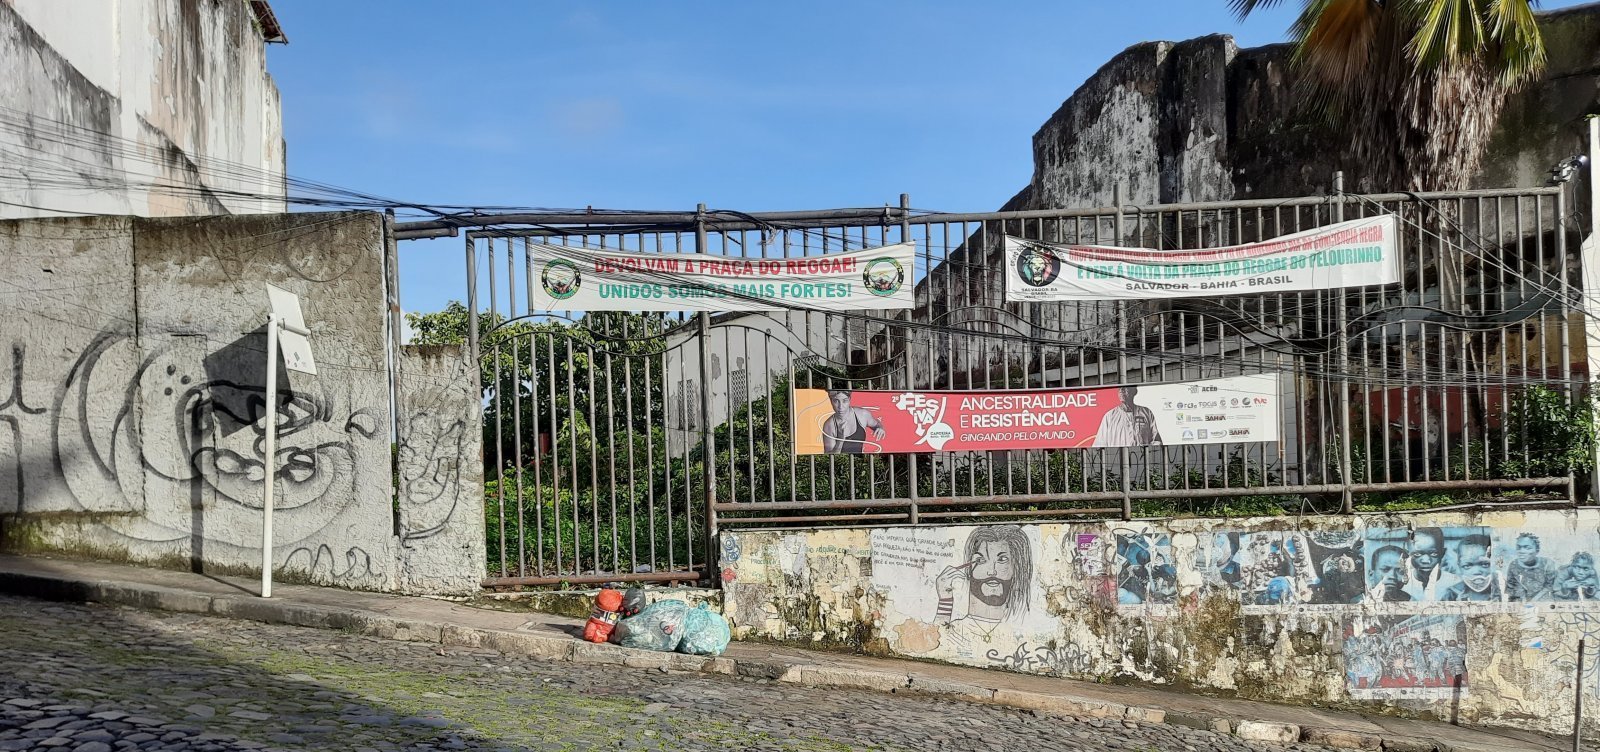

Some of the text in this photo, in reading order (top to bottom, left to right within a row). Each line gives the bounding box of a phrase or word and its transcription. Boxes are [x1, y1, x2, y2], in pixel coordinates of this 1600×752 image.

[595, 256, 857, 278] DEVOLVAM A PRAÇA DO REGGAE!
[1127, 263, 1161, 280] VOLTA
[1164, 264, 1179, 280] DA
[1182, 262, 1221, 281] PRAÇA
[1224, 261, 1240, 276] DO
[1243, 257, 1288, 275] REGGAE
[1290, 254, 1306, 270] DO
[599, 283, 663, 299] UNIDOS
[733, 283, 776, 299] MAIS
[780, 282, 852, 298] FORTES!
[1126, 275, 1293, 291] SALVADOR BAHIA BRASIL
[960, 393, 1097, 411] ANCESTRALIDADE
[960, 409, 1070, 428] E RESISTÊNCIA
[960, 430, 1075, 442] GINGANDO PELO MUNDO
